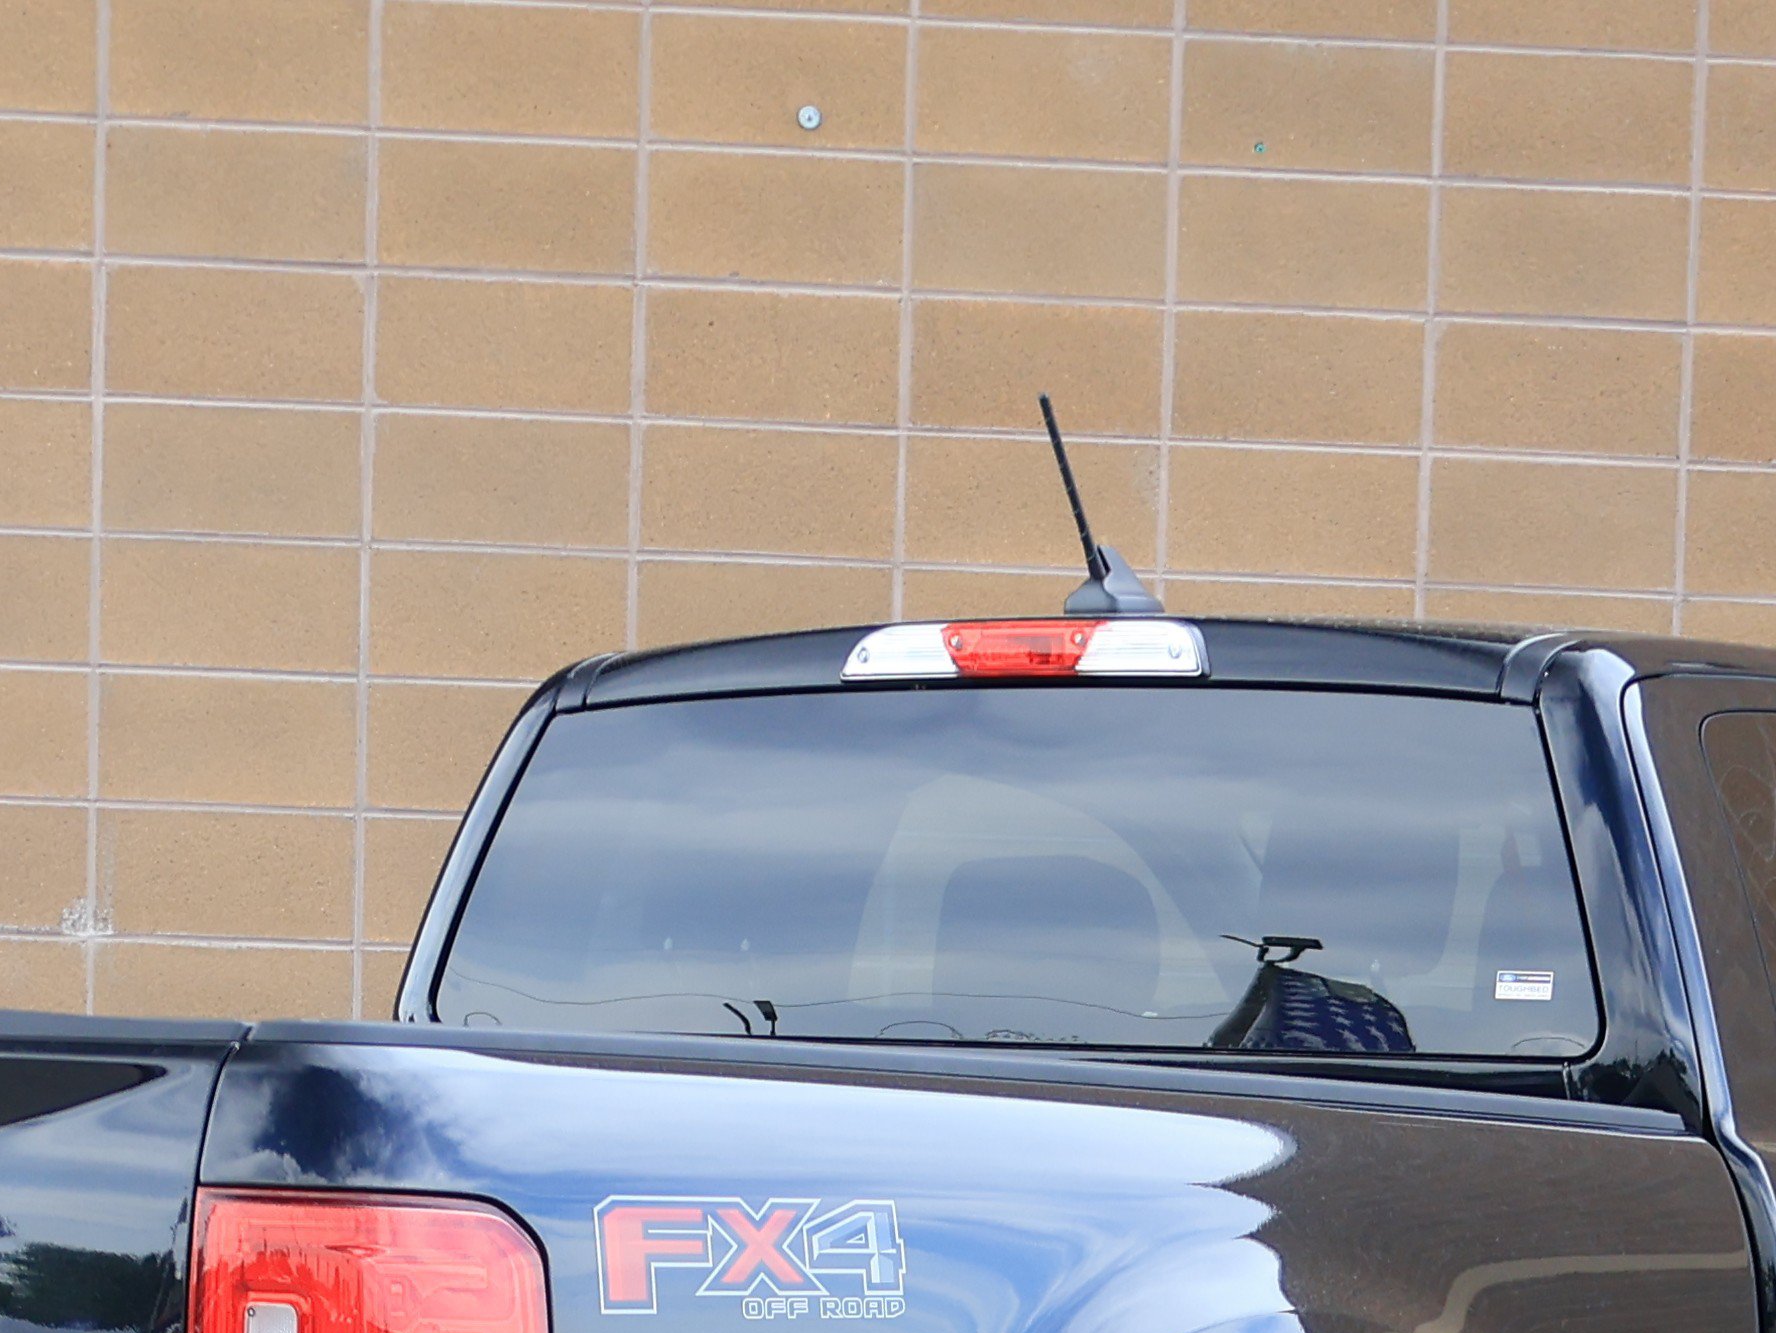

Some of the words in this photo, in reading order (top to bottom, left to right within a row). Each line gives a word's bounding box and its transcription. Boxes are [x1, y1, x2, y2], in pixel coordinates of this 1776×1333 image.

[593, 1195, 907, 1315] FX4
[742, 1297, 810, 1319] OFF
[819, 1297, 906, 1319] ROAD
